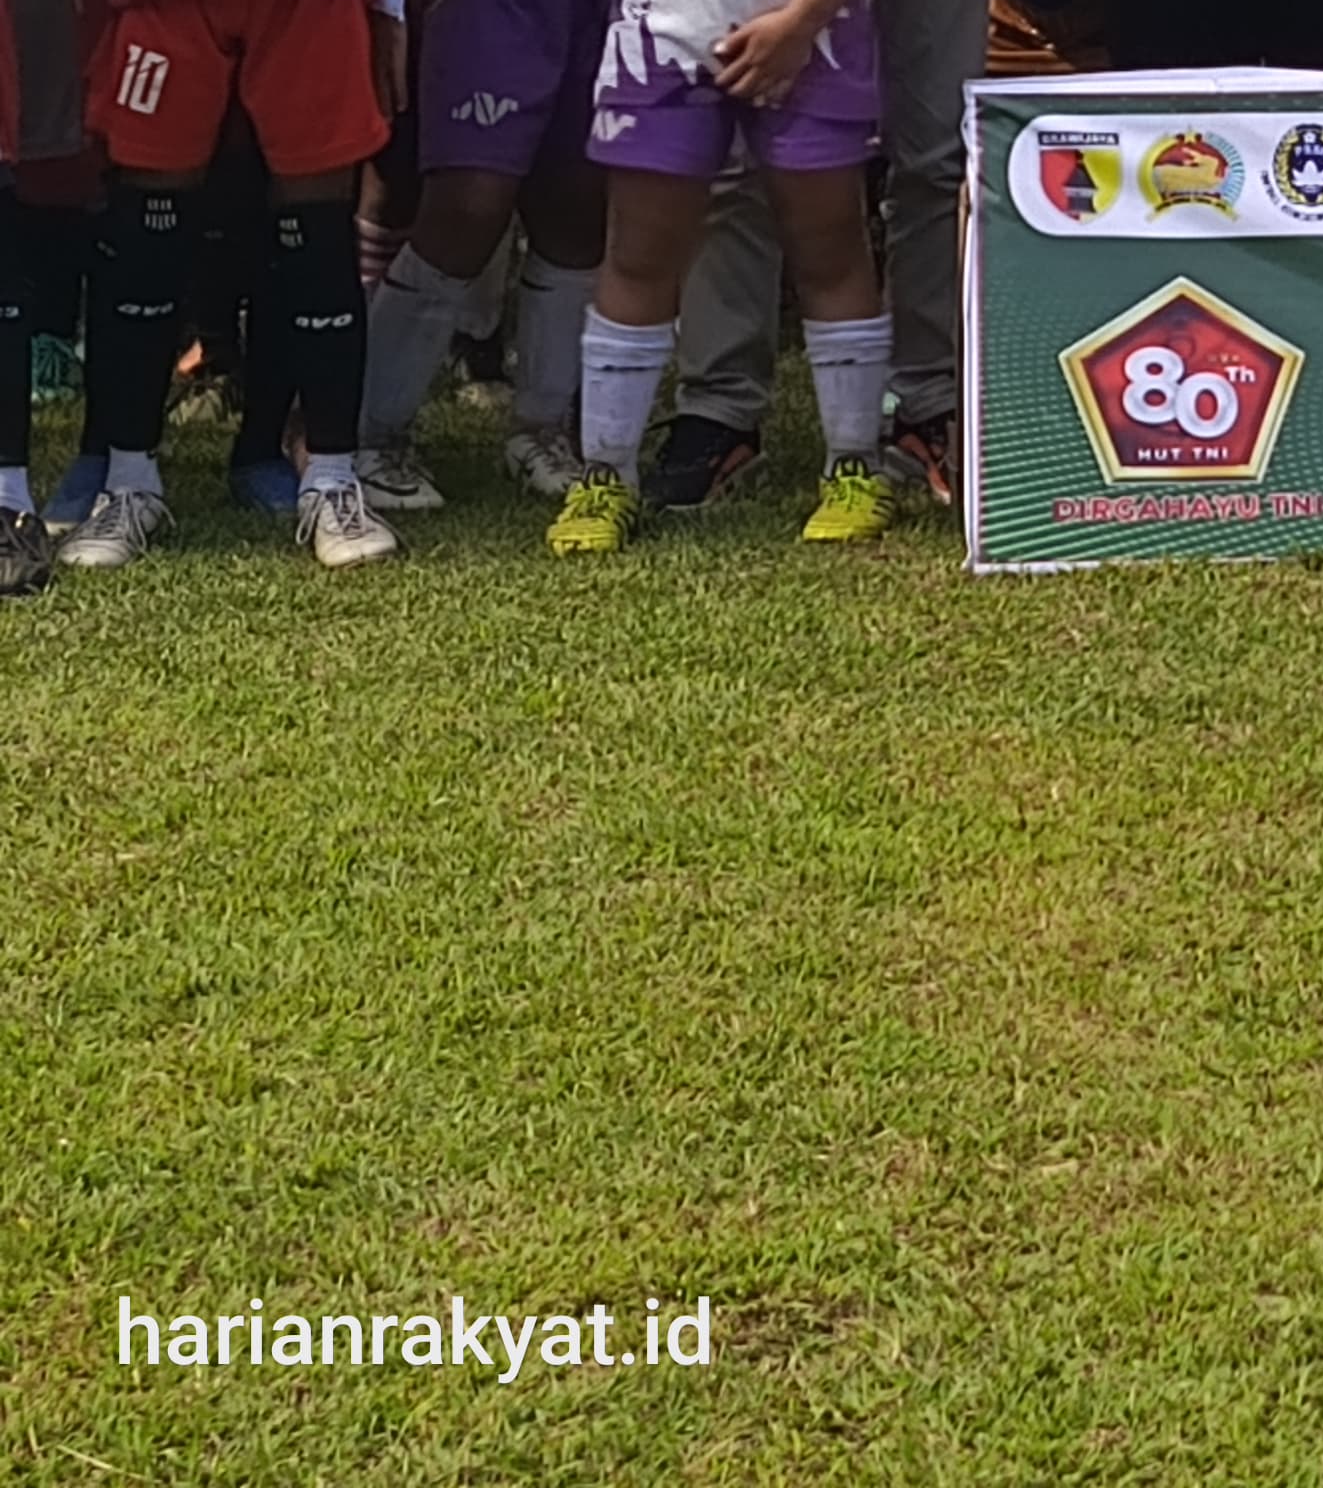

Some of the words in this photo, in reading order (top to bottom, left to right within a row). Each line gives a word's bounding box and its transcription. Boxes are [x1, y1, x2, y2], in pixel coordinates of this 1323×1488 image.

[117, 42, 171, 116] 10
[1122, 346, 1240, 439] 80
[1224, 365, 1256, 383] Th
[1137, 447, 1181, 461] HUT
[1191, 446, 1229, 460] TNI
[1052, 494, 1262, 523] DIRGAHAYU
